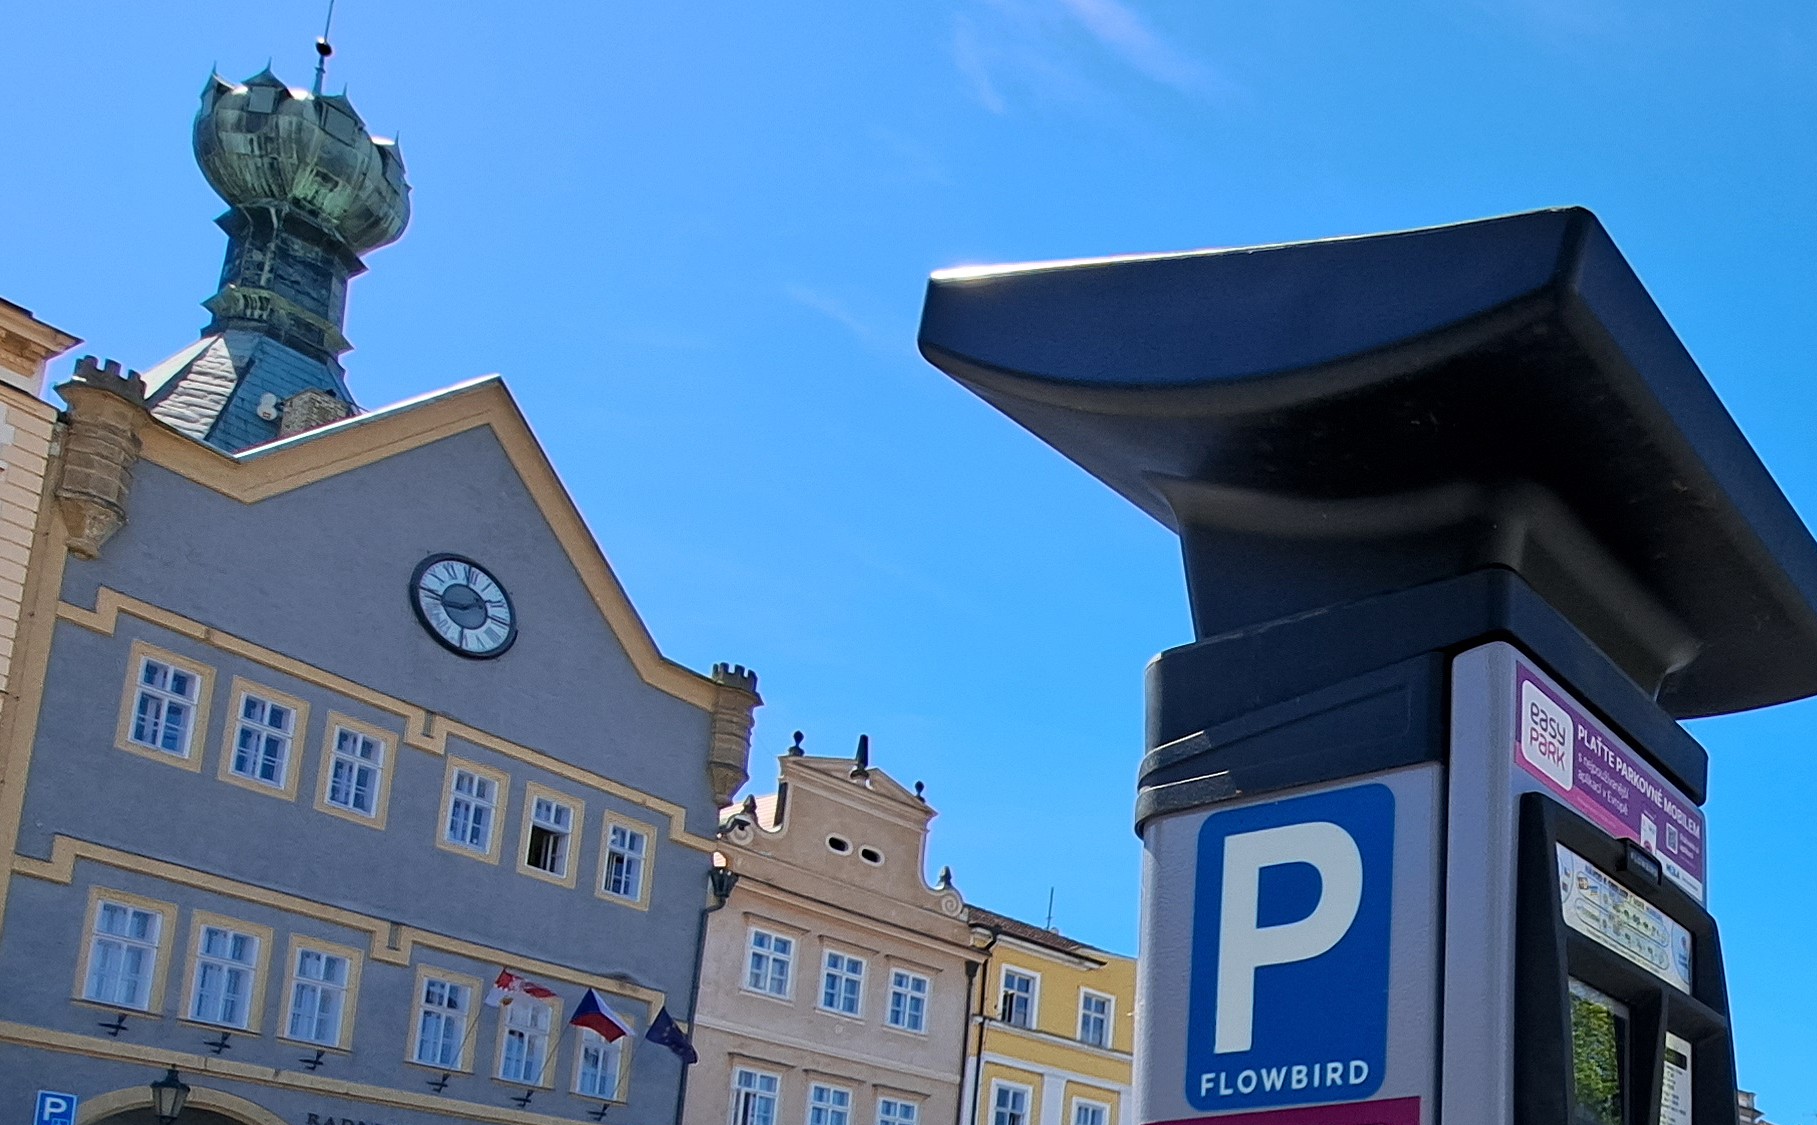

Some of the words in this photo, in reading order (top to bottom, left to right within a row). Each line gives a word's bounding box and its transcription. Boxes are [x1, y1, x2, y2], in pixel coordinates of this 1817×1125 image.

[1530, 702, 1566, 747] easy
[1214, 821, 1363, 1055] P
[1200, 1060, 1369, 1097] FLOWBIRD
[43, 1097, 68, 1121] P
